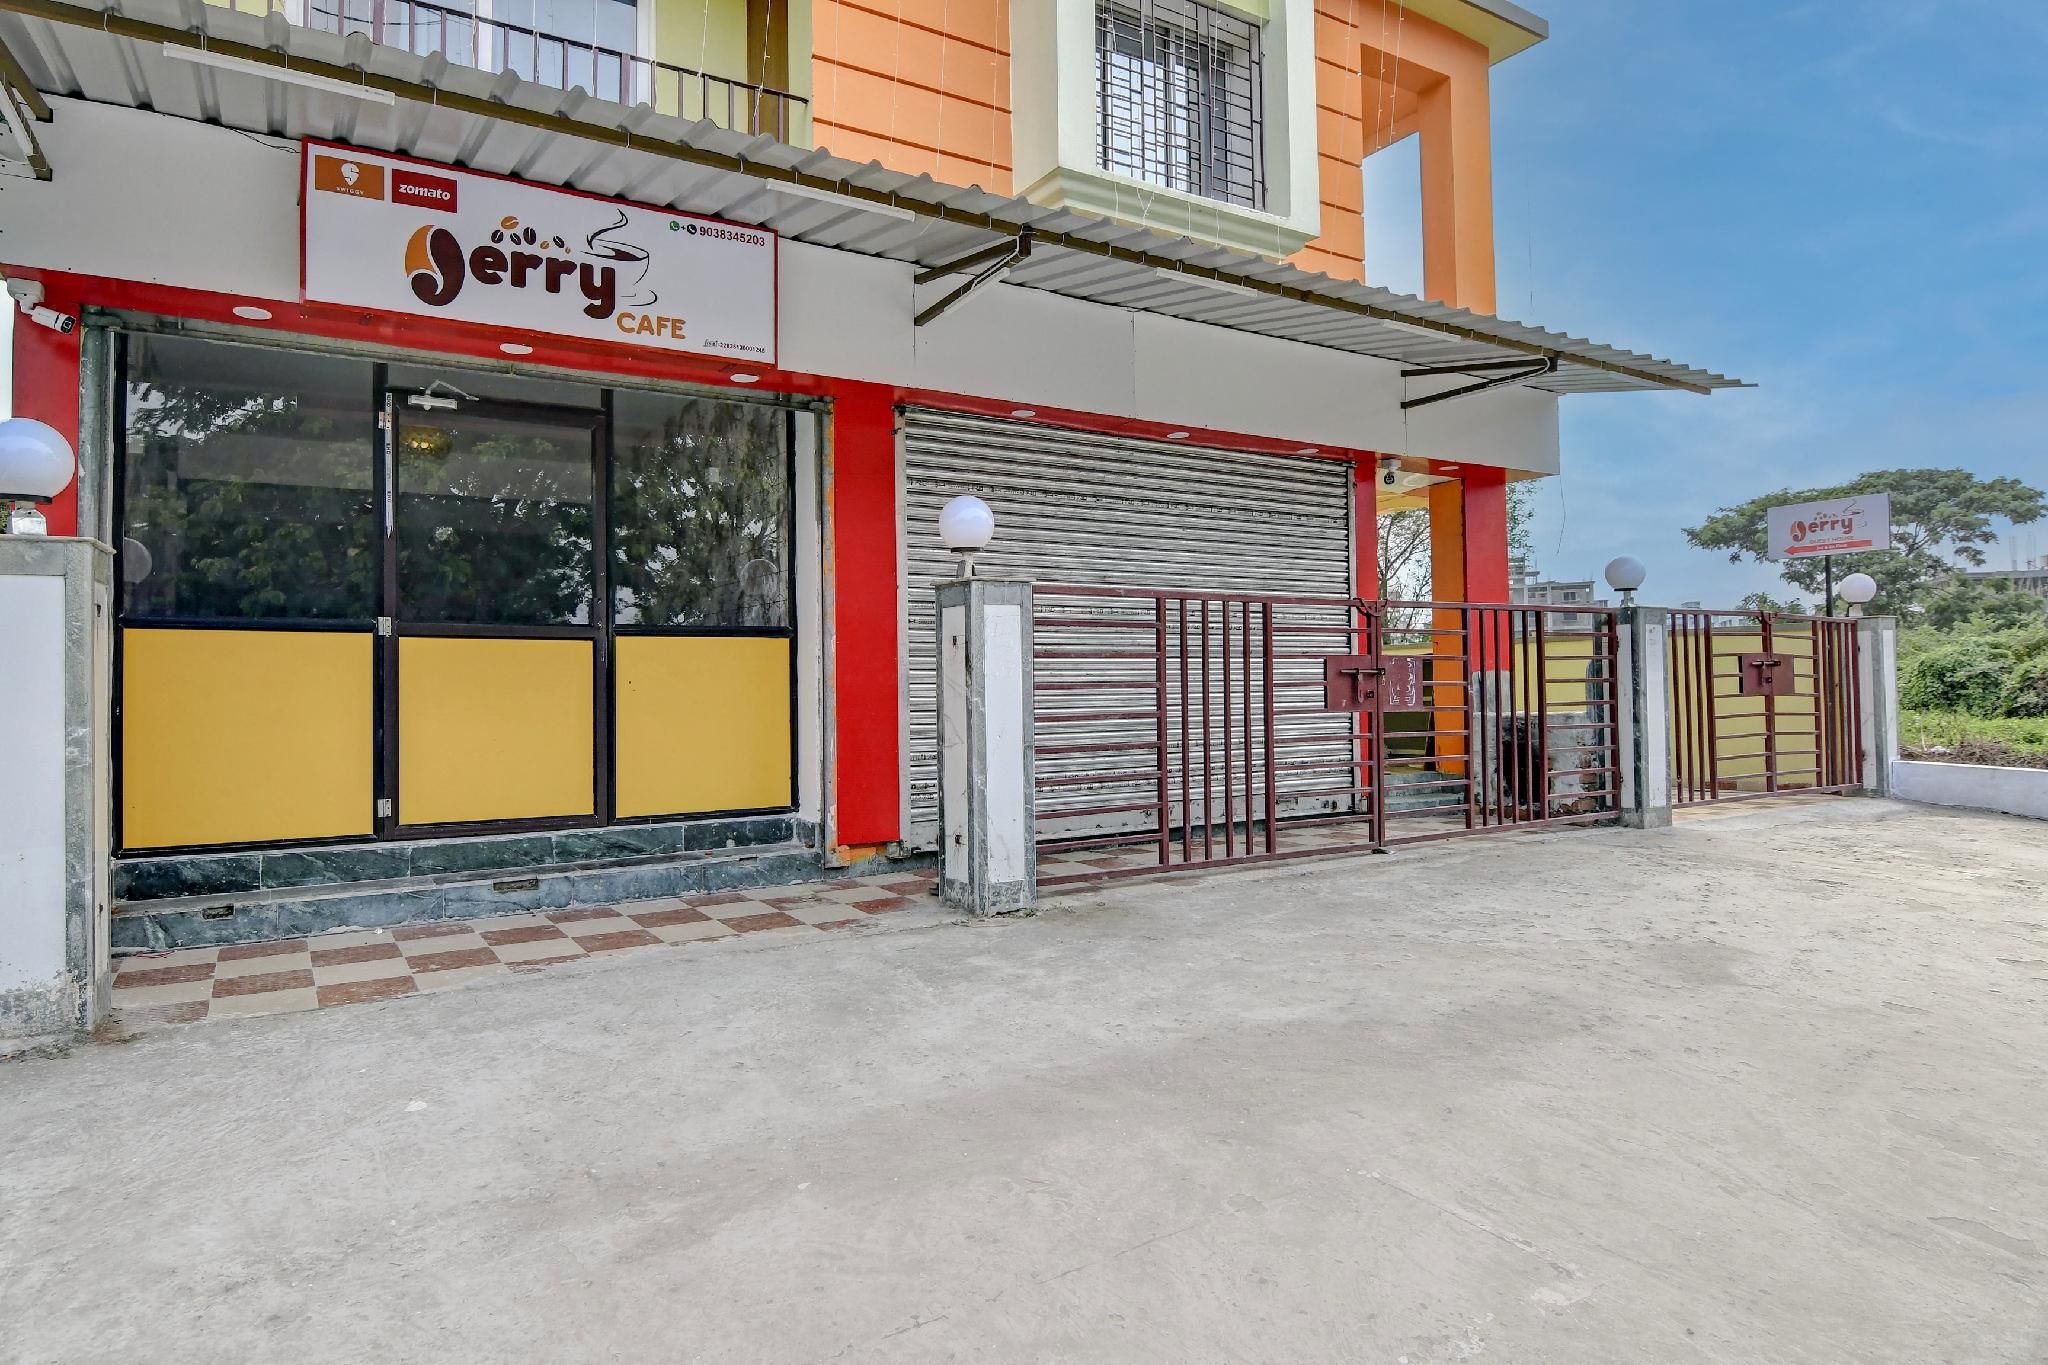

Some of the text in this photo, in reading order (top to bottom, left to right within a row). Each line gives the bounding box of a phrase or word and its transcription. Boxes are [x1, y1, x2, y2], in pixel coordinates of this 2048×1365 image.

[336, 186, 365, 196] SWIGGY
[398, 183, 451, 201] zomato
[699, 226, 766, 247] 9038345203
[616, 312, 687, 340] CAFE
